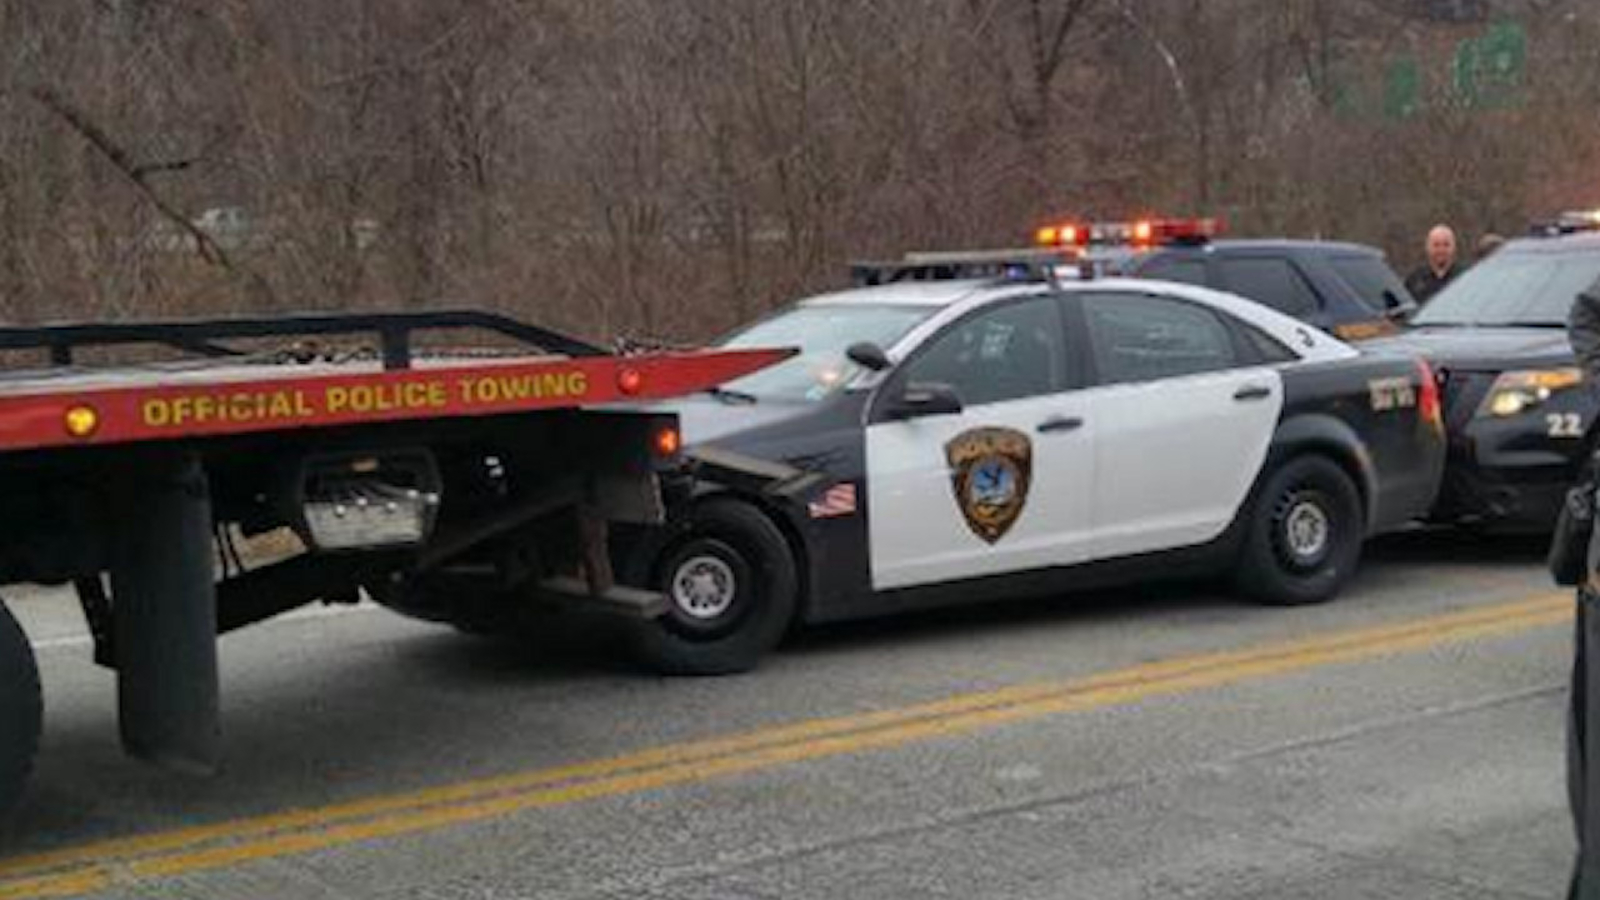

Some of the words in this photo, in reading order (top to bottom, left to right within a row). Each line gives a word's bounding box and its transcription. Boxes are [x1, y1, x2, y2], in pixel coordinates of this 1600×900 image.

[143, 389, 315, 427] OFFICIAL
[326, 381, 446, 413] POLICE
[460, 371, 588, 403] TOWING
[1546, 413, 1584, 437] 22
